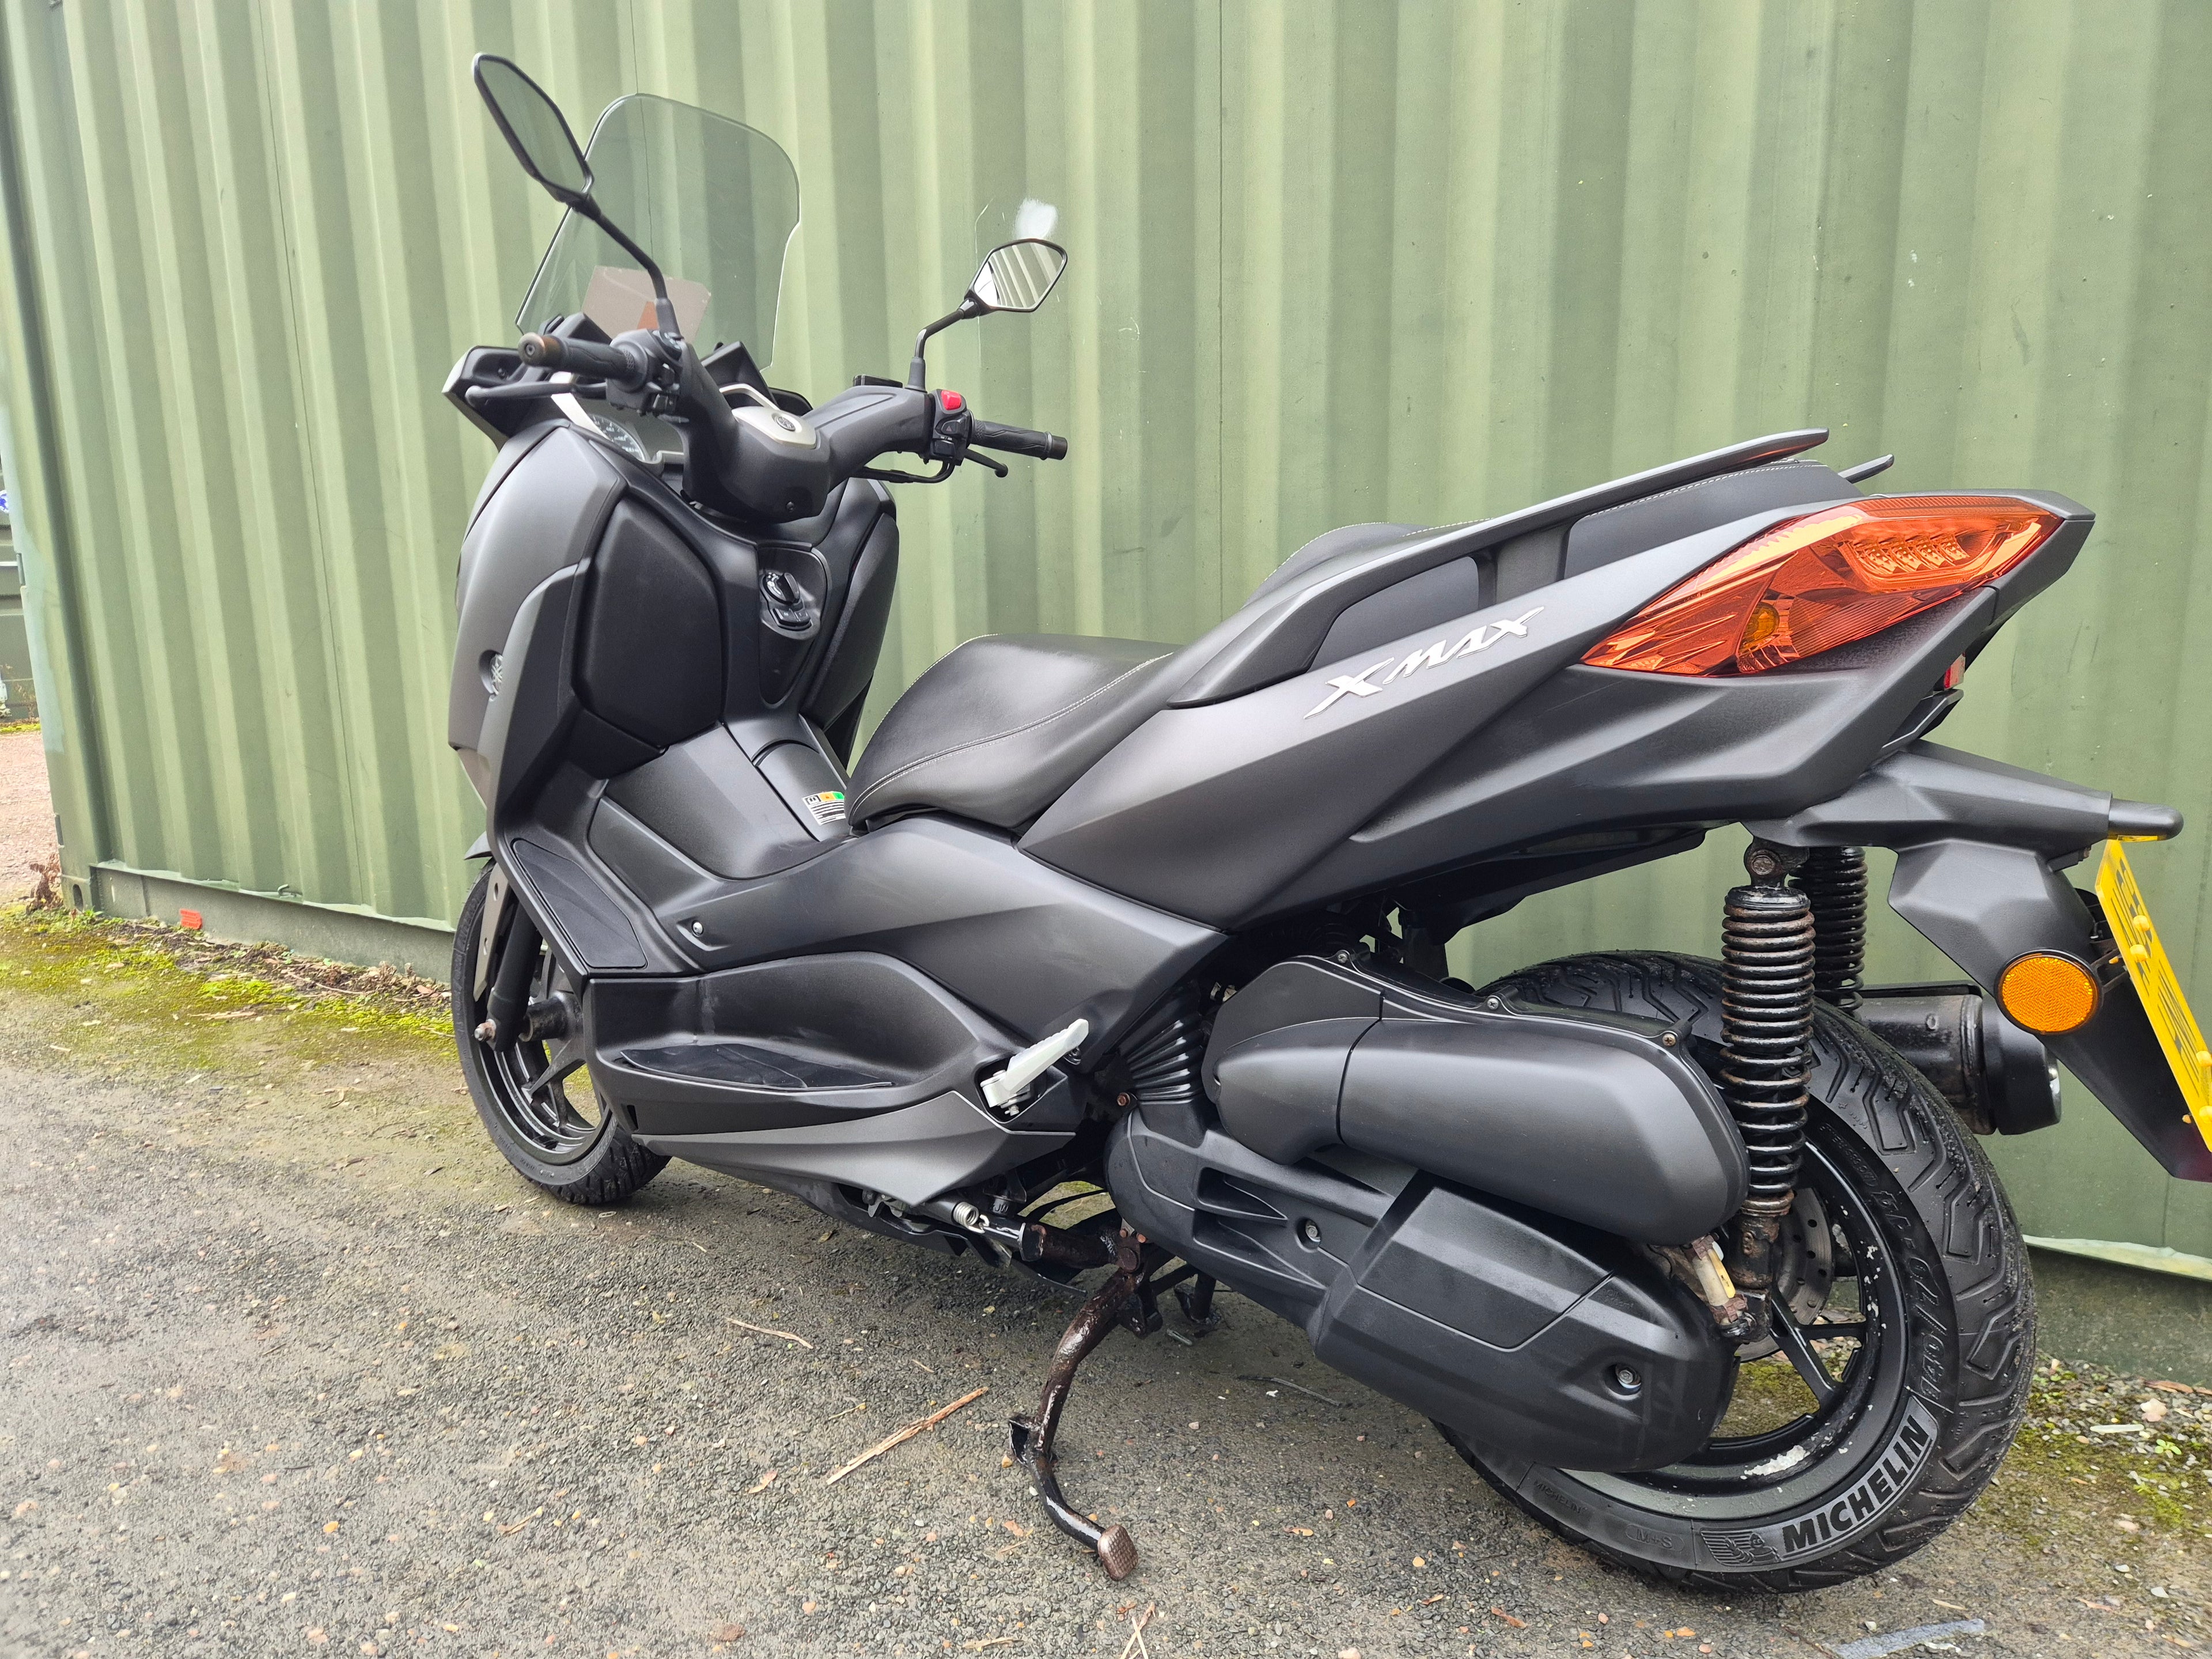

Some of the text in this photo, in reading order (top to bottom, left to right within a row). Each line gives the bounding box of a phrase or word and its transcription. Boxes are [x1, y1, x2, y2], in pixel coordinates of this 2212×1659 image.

[1303, 607, 1544, 719] XMAX
[1533, 1479, 1582, 1514] MICHELIN
[1782, 1415, 1930, 1552] MICHELIN
[1636, 1528, 1673, 1549] M+S
